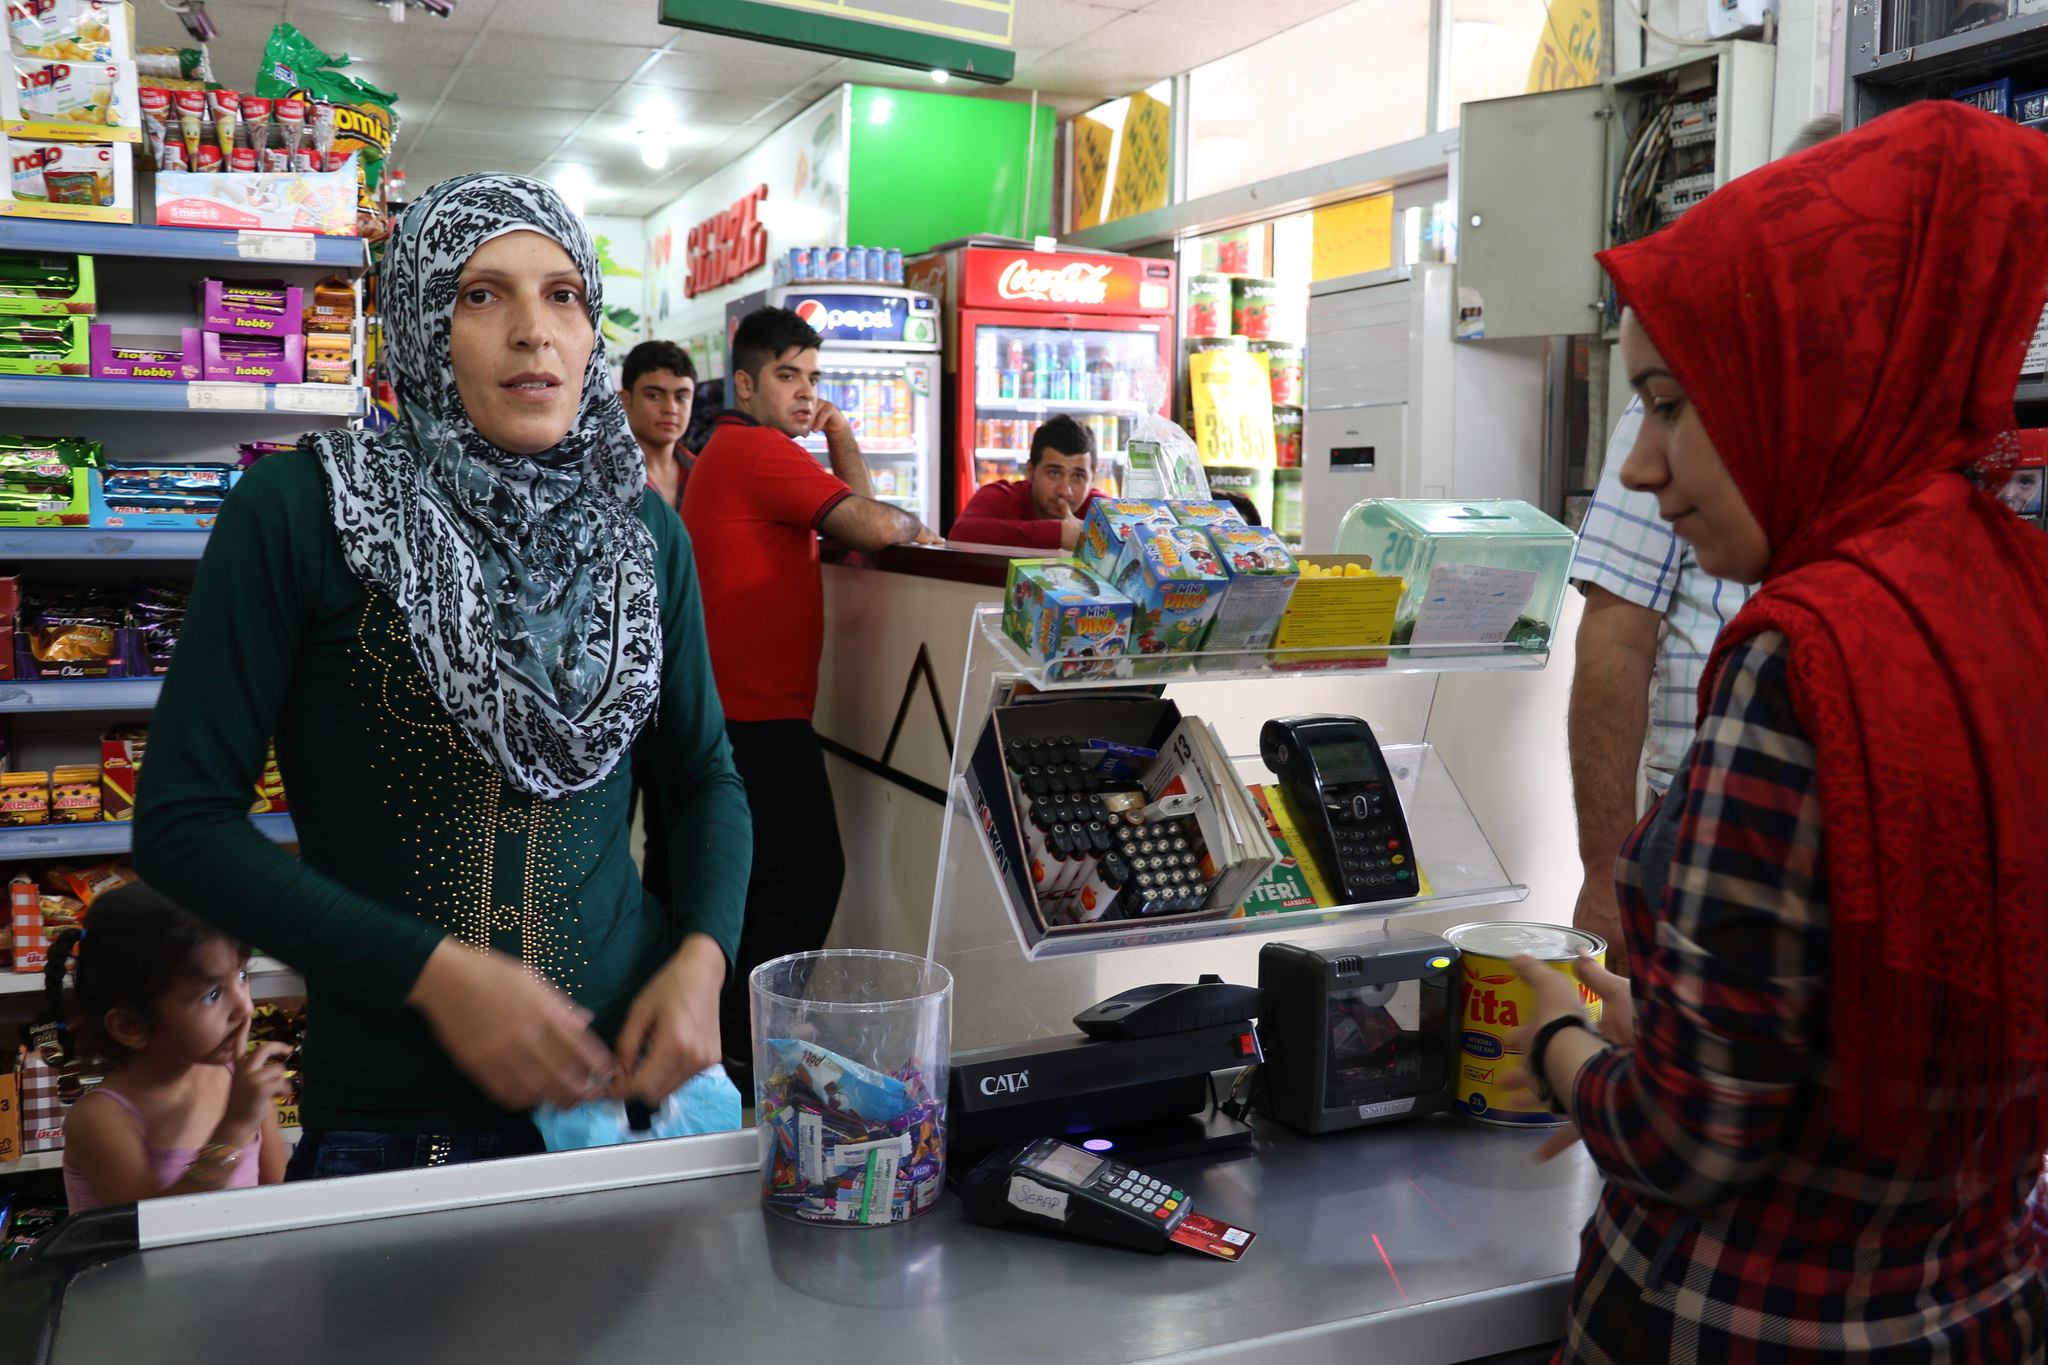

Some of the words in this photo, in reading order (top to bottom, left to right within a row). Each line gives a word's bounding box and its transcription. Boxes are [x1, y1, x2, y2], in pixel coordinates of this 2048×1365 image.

[234, 316, 276, 330] hobby
[827, 308, 893, 331] pepsi
[132, 366, 176, 378] hobby
[234, 365, 275, 378] hobby
[1163, 593, 1209, 610] DINO
[1076, 616, 1116, 636] DINO
[1173, 733, 1192, 766] 13
[980, 1071, 1029, 1096] CATA
[1016, 1184, 1060, 1210] SERAP
